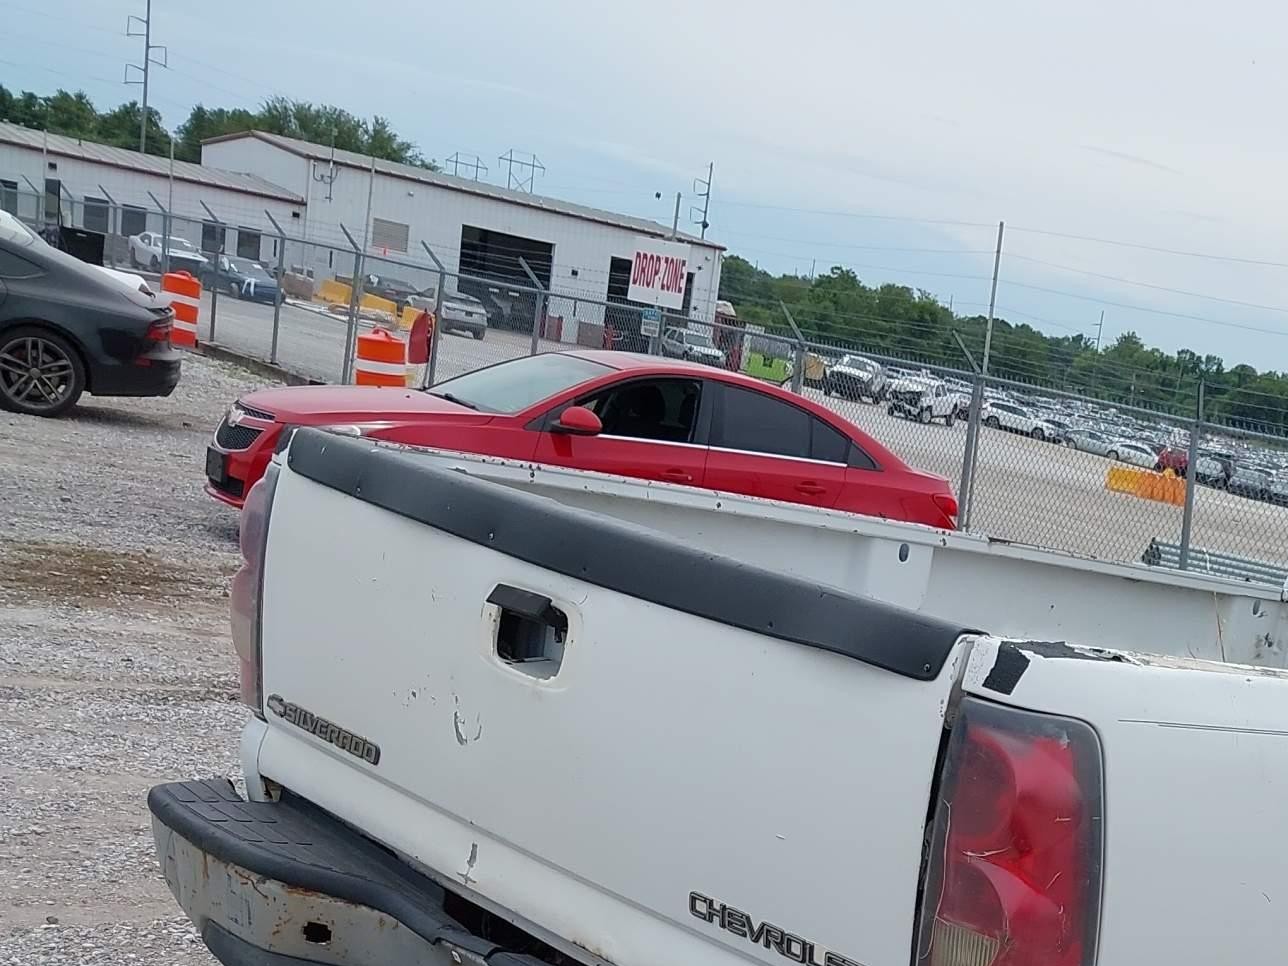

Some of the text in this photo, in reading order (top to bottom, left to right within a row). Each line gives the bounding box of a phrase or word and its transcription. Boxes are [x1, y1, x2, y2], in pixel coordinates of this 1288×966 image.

[633, 252, 686, 293] DROP ZONE
[284, 702, 380, 766] SILVERADO
